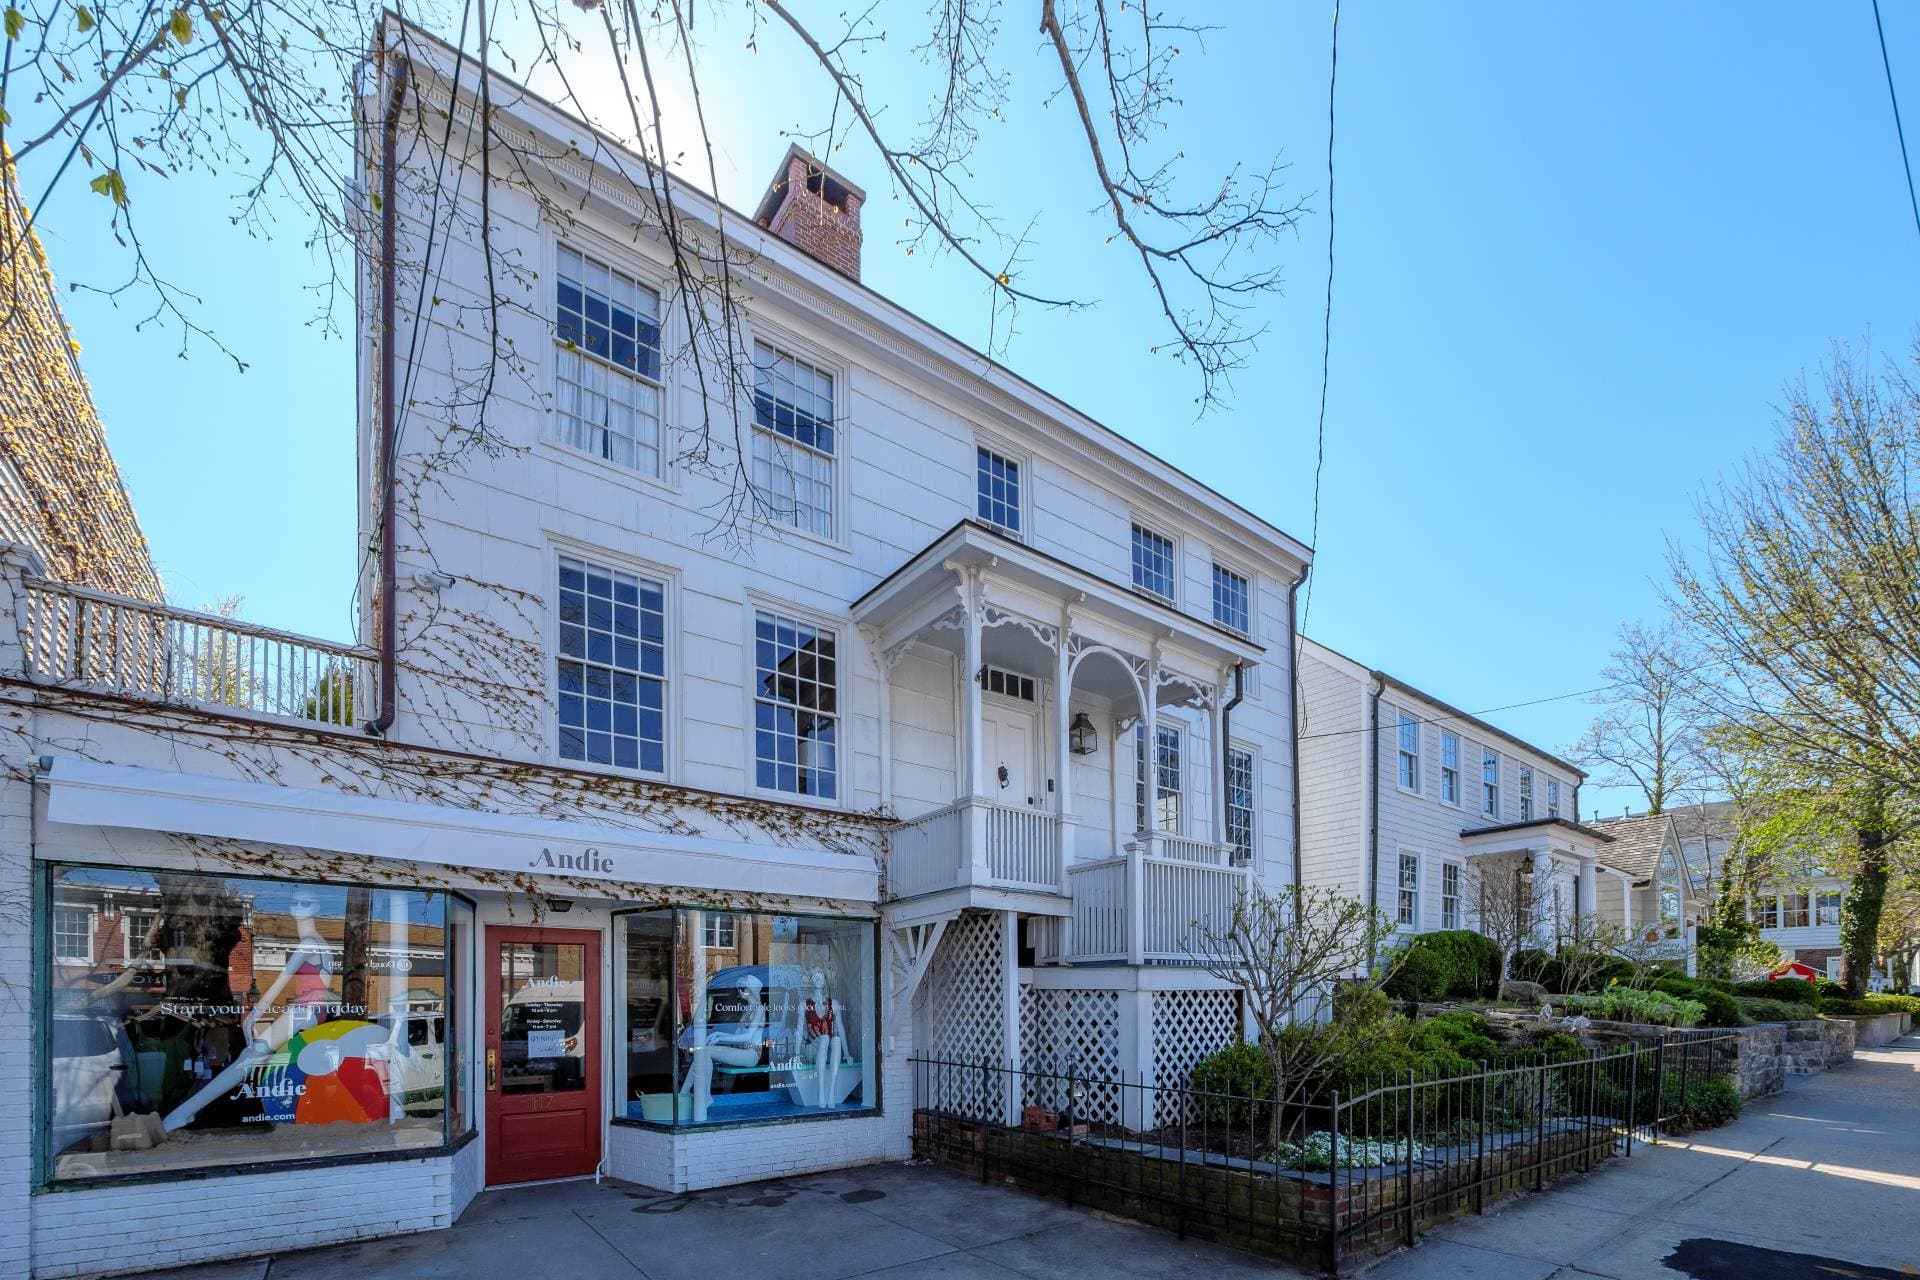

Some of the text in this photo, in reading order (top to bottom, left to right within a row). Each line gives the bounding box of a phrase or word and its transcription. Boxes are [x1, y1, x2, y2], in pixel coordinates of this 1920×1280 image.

[529, 848, 614, 873] Andie
[522, 975, 566, 989] Andie
[160, 1002, 204, 1016] Start
[208, 1004, 250, 1018] your
[763, 1057, 803, 1073] Andie
[230, 1078, 307, 1100] Andie
[532, 1095, 555, 1110] 117
[241, 1113, 296, 1123] andie.com
